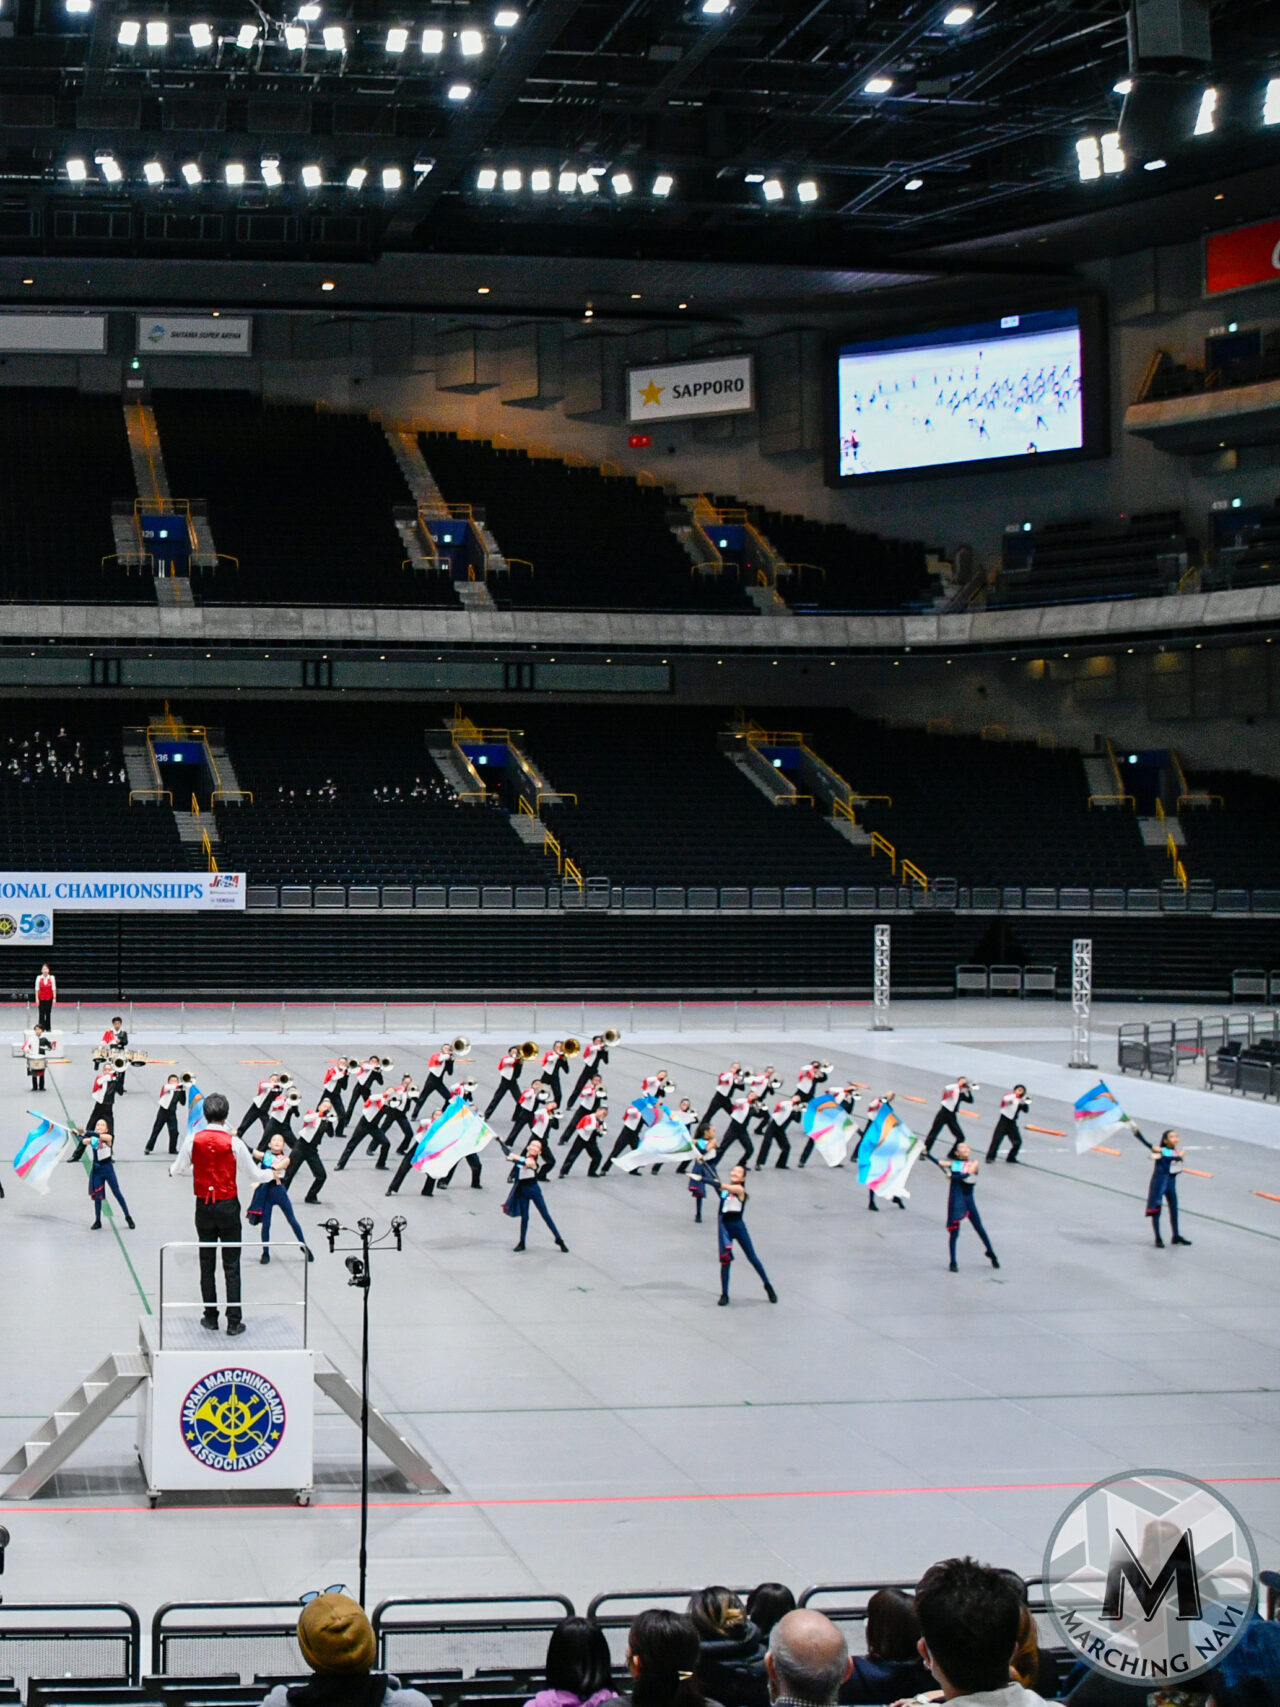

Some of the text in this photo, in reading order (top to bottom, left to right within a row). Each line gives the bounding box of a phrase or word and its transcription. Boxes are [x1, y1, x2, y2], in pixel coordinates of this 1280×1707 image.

[199, 331, 220, 340] SUPER
[221, 332, 242, 340] ARENA
[672, 377, 745, 400] SAPPORO
[55, 882, 204, 900] CHAMPIONSHIPS
[182, 1369, 285, 1425] JAPAN MARCHINGBAND
[190, 1441, 274, 1471] ASSOCIATION
